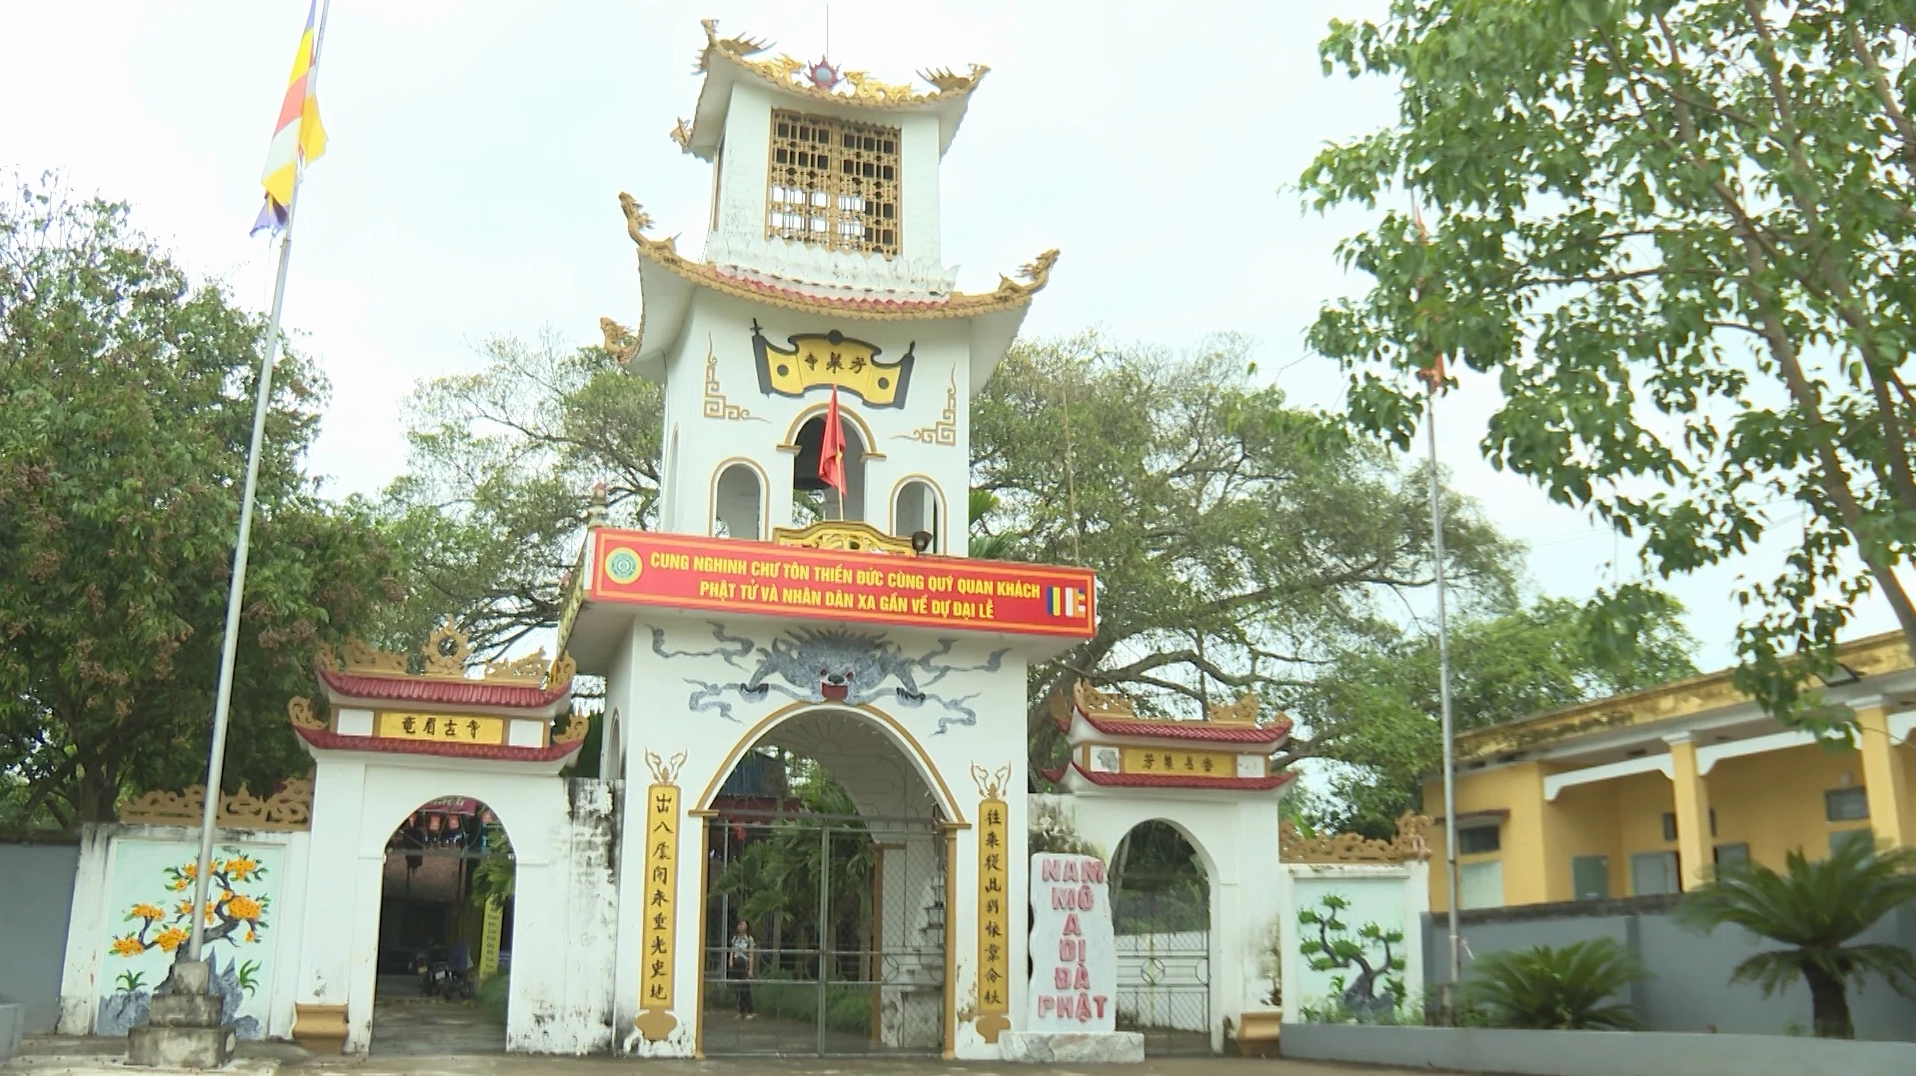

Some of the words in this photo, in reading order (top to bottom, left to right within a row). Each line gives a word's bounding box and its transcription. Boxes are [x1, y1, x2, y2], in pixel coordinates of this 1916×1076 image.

[650, 551, 690, 571] CUNG
[693, 555, 748, 575] NGHINH
[751, 561, 781, 579] CHƯ
[783, 561, 810, 580] TÔN
[888, 570, 924, 590] CÙNG
[957, 578, 994, 595] QUAN
[997, 580, 1041, 599] KHÁCH
[700, 579, 736, 602] PHẬT
[740, 578, 759, 600] TỬ
[761, 583, 779, 602] VÀ
[782, 587, 822, 606] NHÂN
[825, 589, 854, 608] DÂN
[857, 593, 876, 610] XA
[931, 599, 952, 618] DỰ
[953, 601, 976, 621] ĐẠI
[1042, 858, 1106, 883] NAM
[1051, 884, 1094, 911] MÔ
[1063, 913, 1081, 935] A
[1054, 960, 1090, 989] ĐÀ
[1038, 992, 1108, 1023] PHẬT
